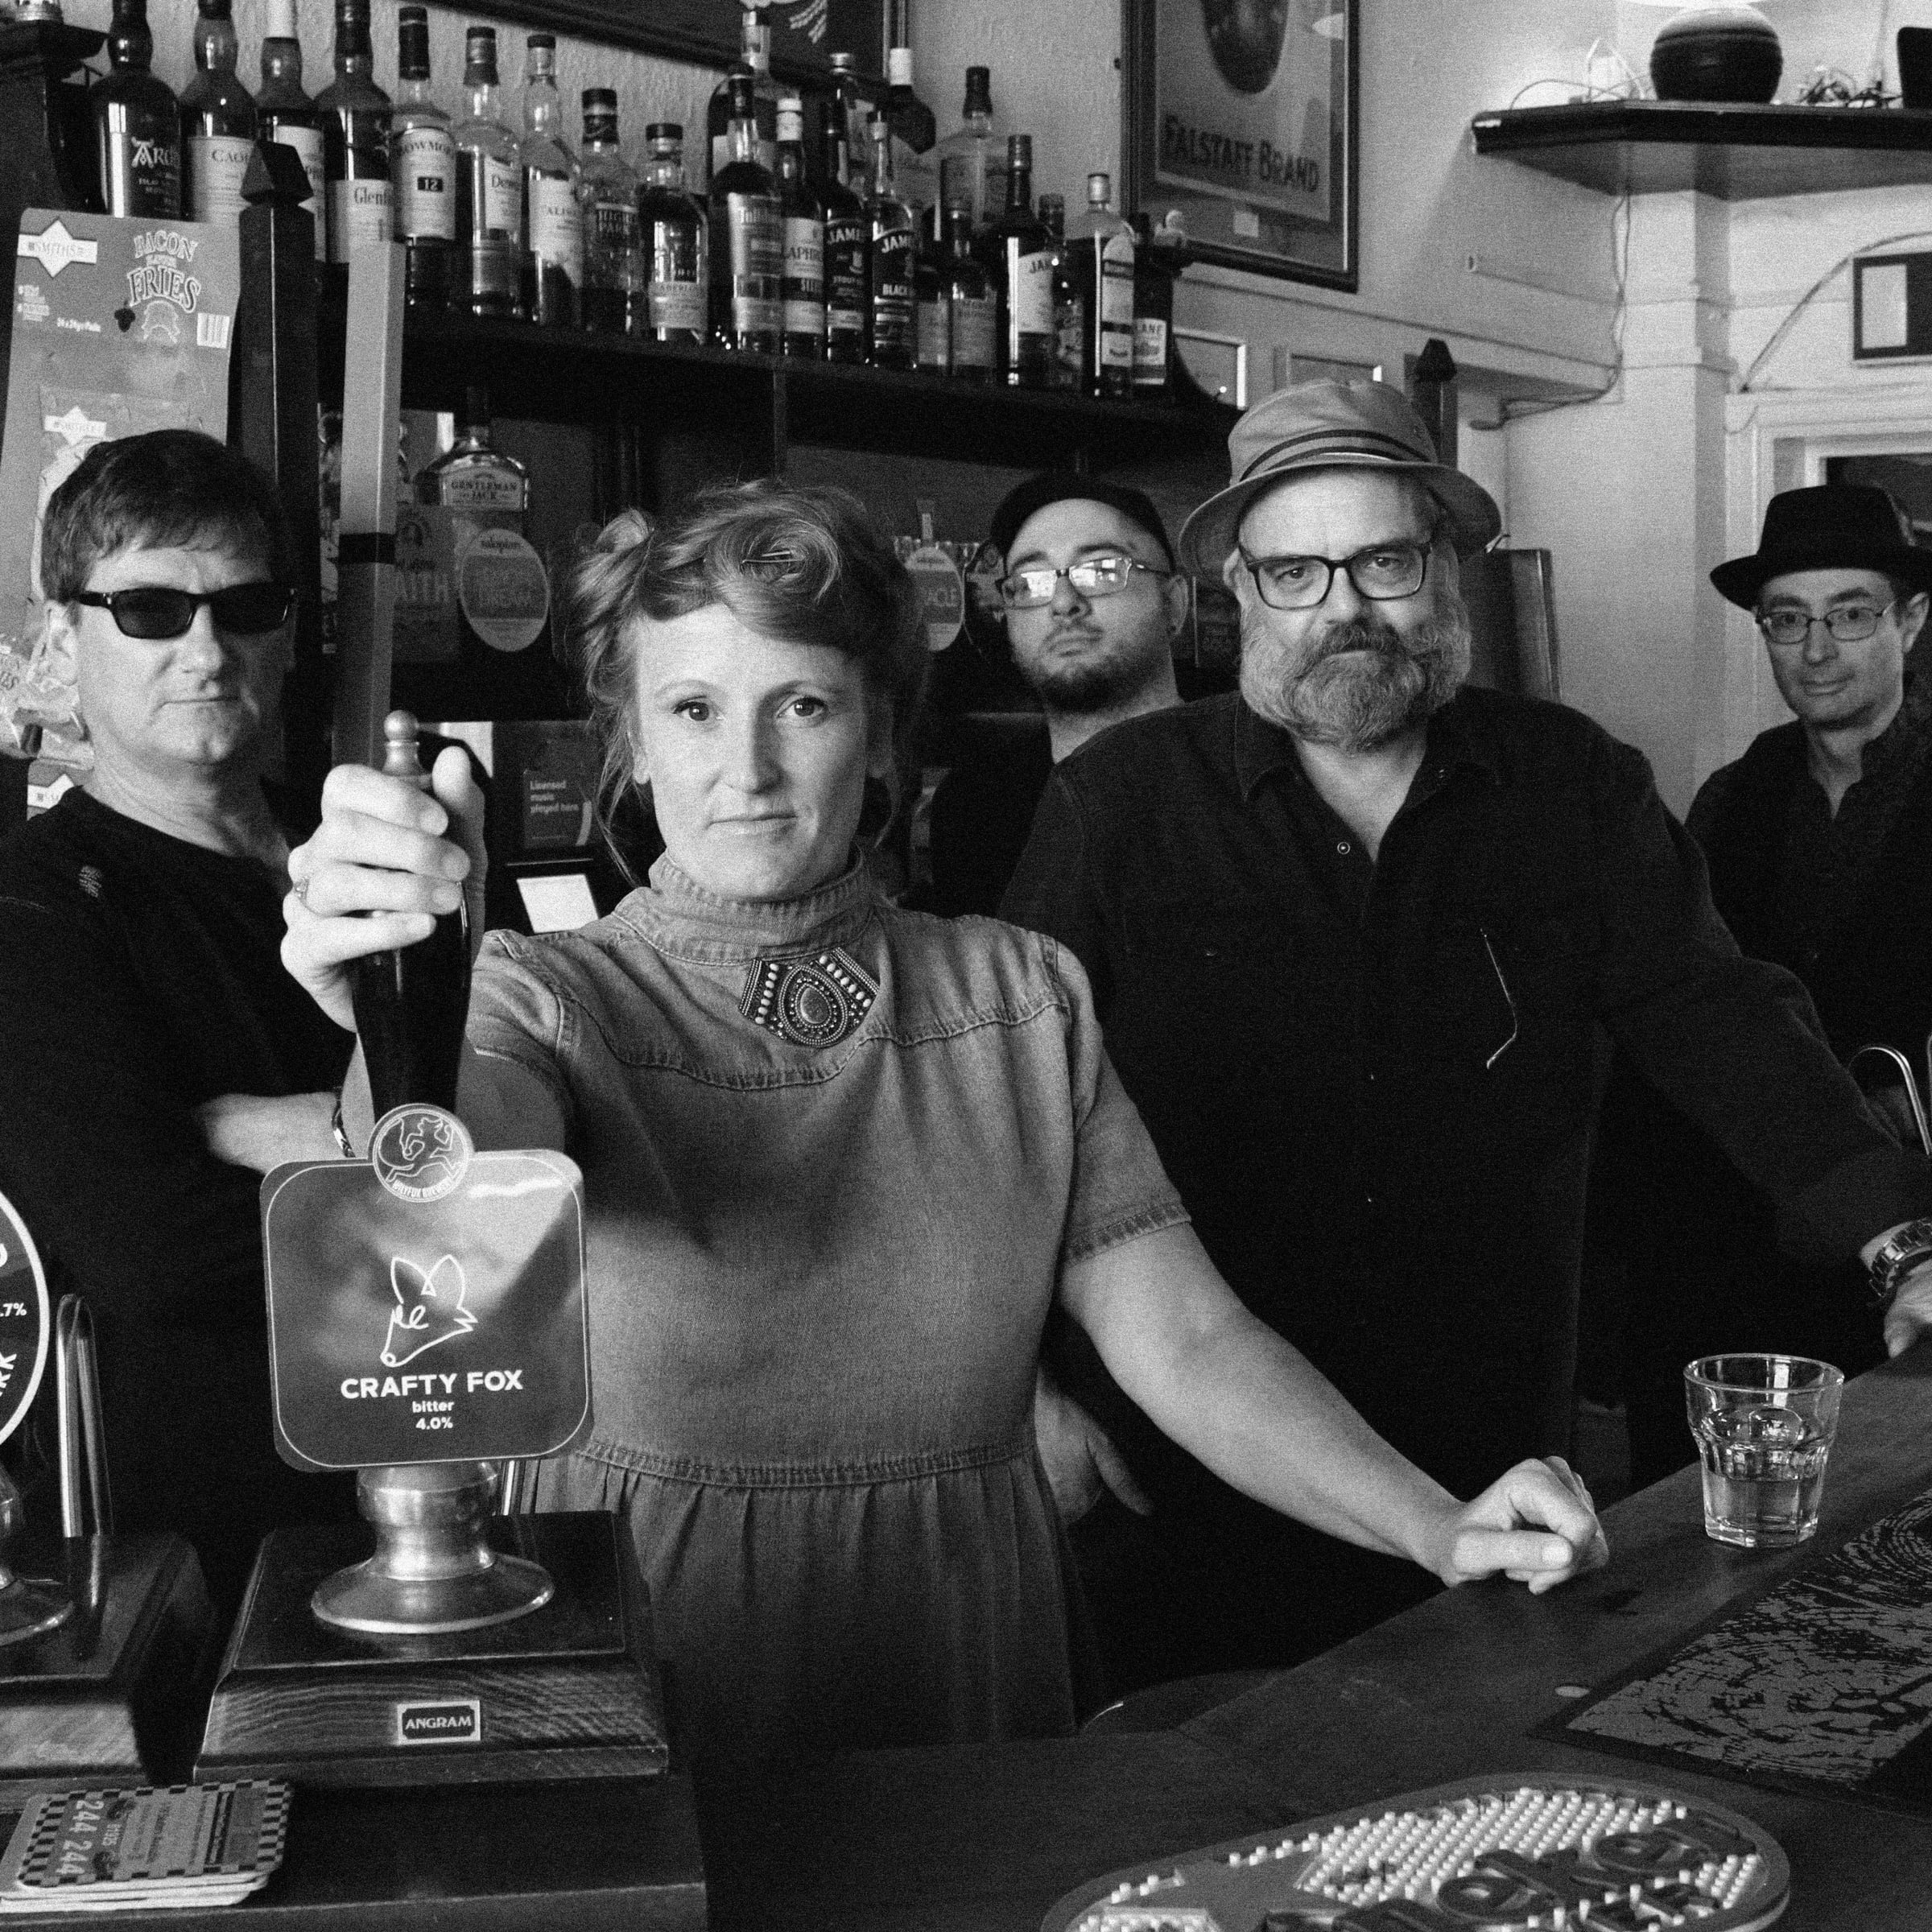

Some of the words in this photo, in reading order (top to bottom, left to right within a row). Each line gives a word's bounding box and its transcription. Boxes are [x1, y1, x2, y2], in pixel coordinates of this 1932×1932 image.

[423, 178, 439, 190] 12
[134, 229, 199, 262] BACON
[127, 264, 202, 314] FRIES
[341, 1373, 458, 1399] CRAFTY
[467, 1369, 523, 1393] FOX
[411, 1400, 456, 1414] bitter
[415, 1416, 454, 1431] 4.0%
[405, 1715, 473, 1730] ANGRAM
[68, 1799, 105, 1834] 244
[55, 1839, 93, 1876] 244
